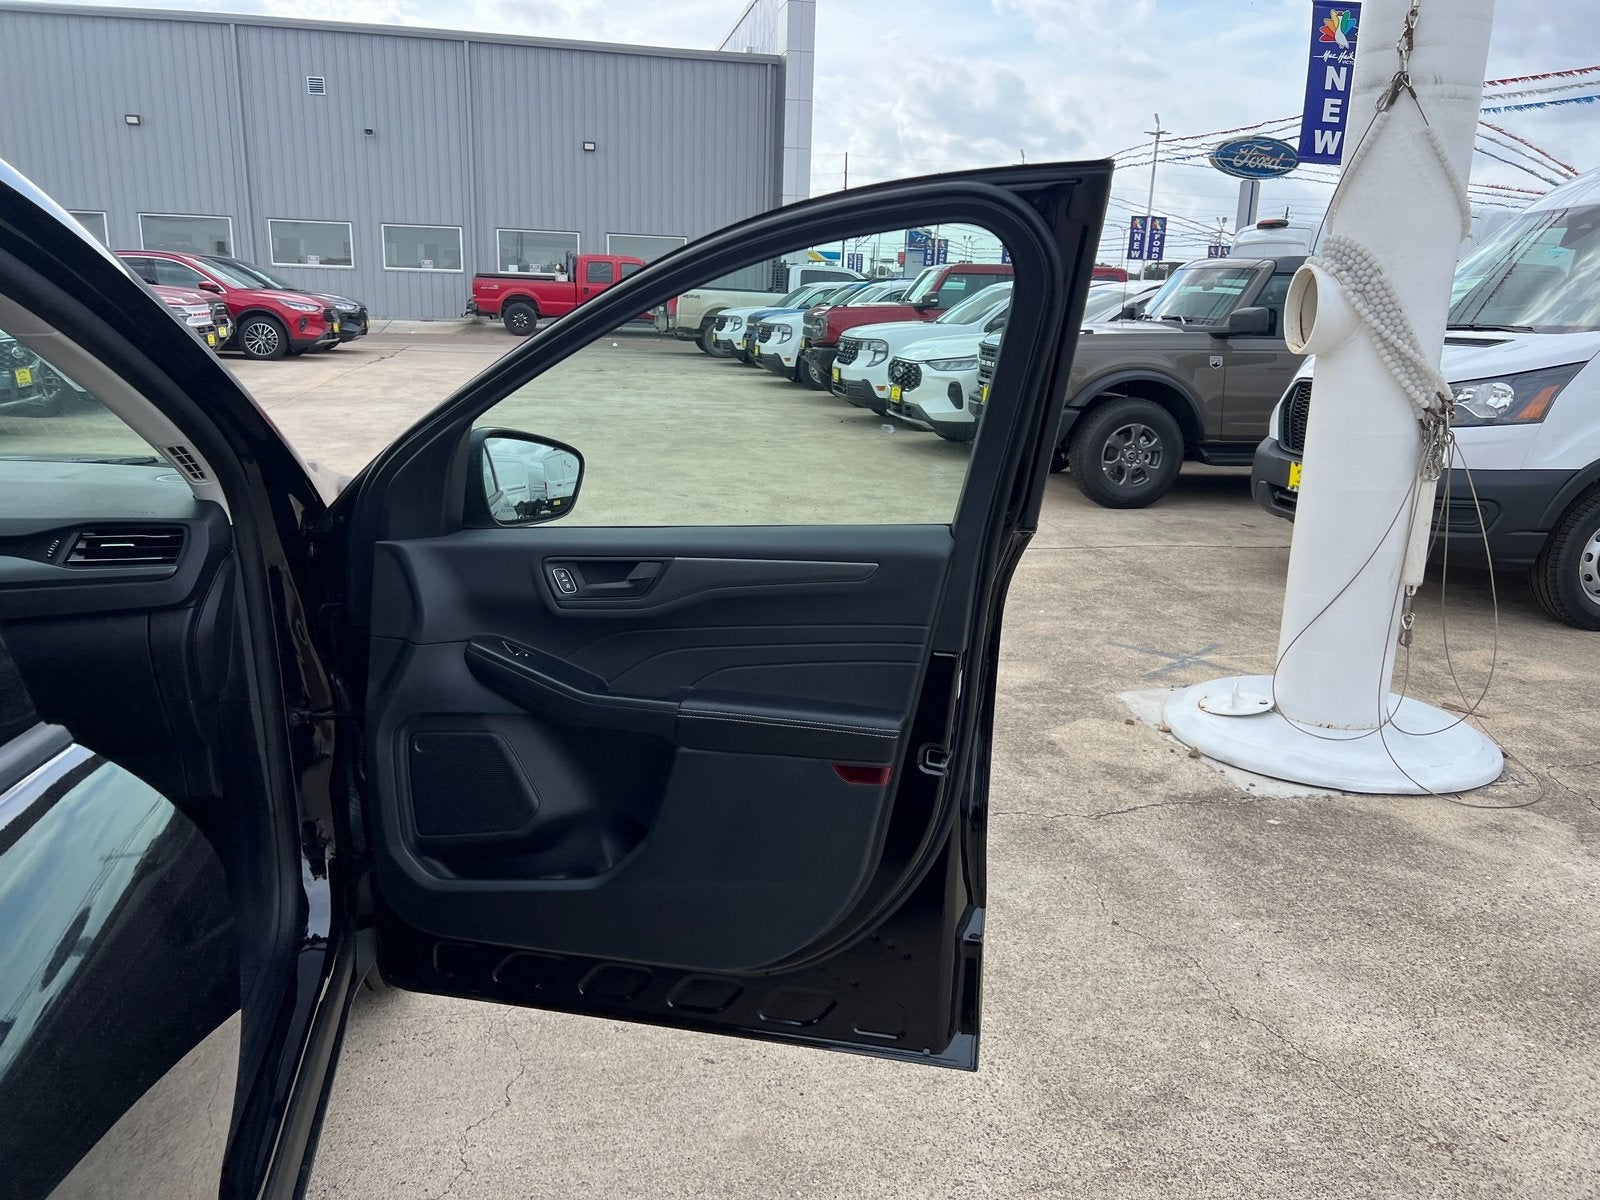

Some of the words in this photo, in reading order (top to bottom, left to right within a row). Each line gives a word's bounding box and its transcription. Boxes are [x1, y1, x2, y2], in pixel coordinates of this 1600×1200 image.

[1314, 65, 1347, 155] NEW
[1232, 143, 1284, 169] Ford
[1131, 233, 1141, 258] NEW
[1151, 234, 1160, 259] FORD
